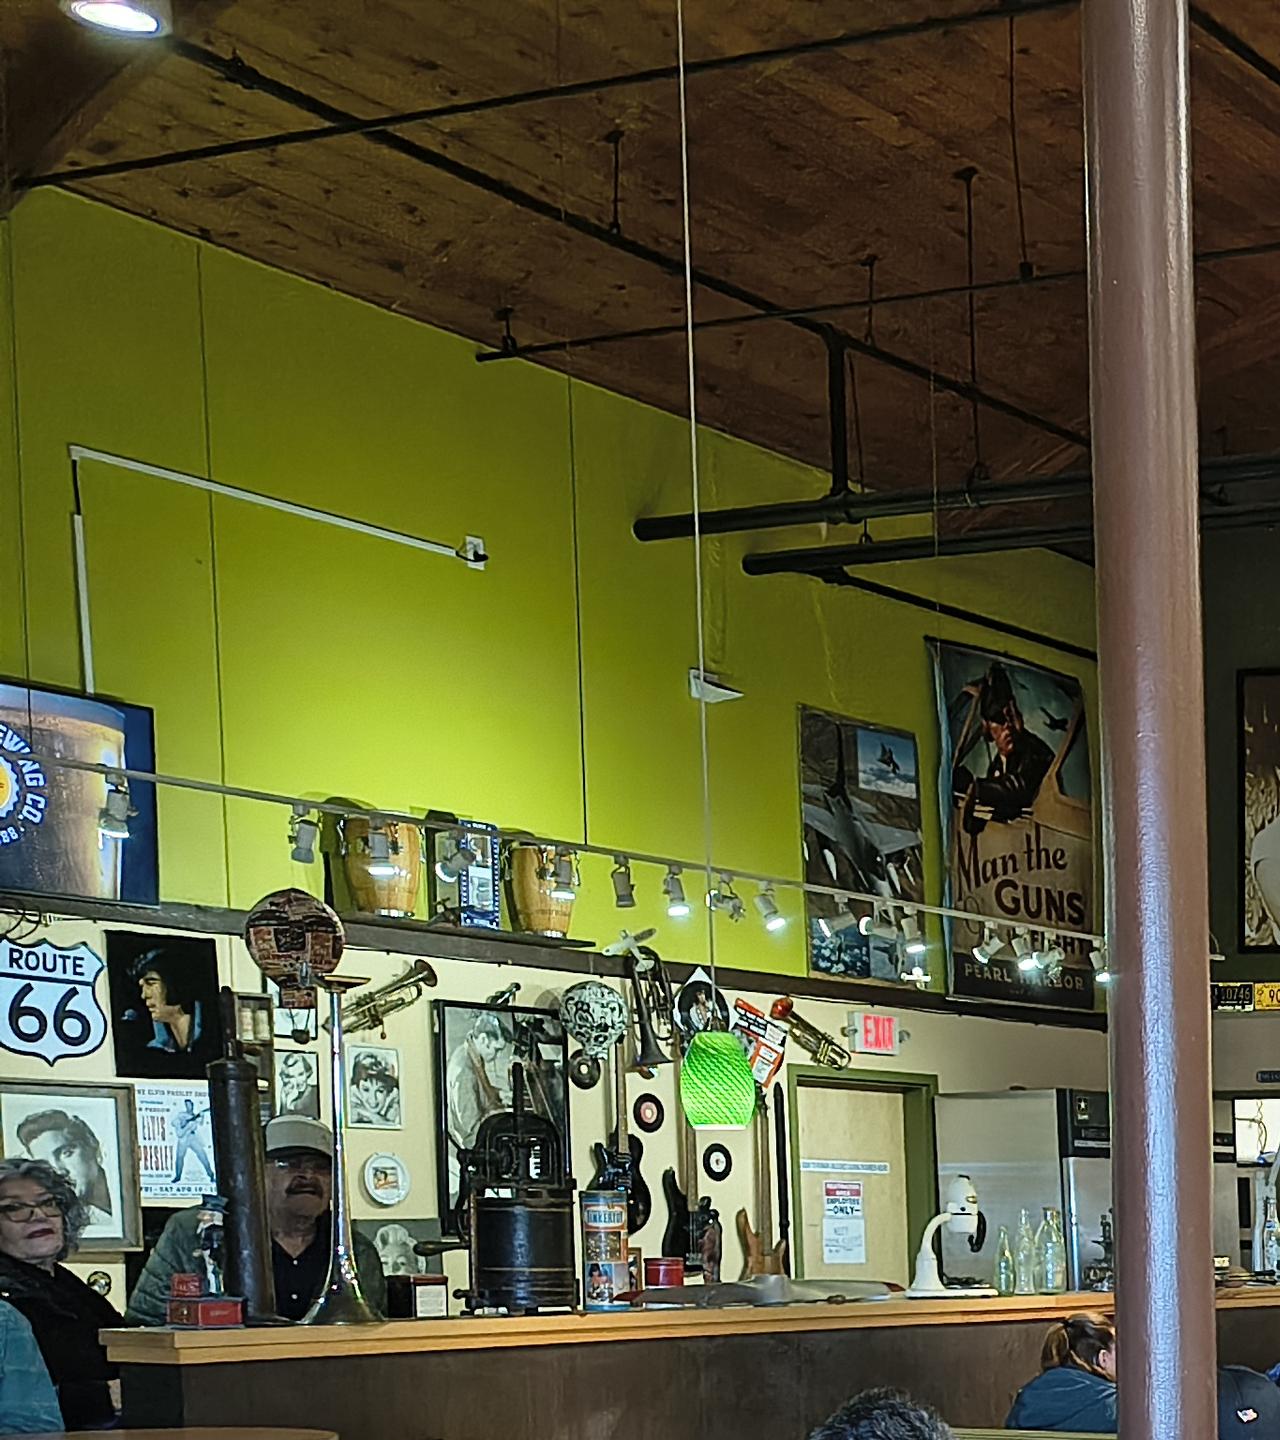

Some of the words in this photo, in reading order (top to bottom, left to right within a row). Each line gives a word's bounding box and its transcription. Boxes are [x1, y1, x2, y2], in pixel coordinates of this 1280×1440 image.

[956, 828, 1019, 902] Man
[1023, 820, 1068, 873] the
[994, 879, 1085, 926] GUNS
[8, 947, 85, 976] ROUTE
[964, 963, 1012, 983] PEARL
[7, 981, 91, 1047] 66
[863, 1014, 895, 1050] EXIT
[832, 1205, 855, 1215] ONLY
